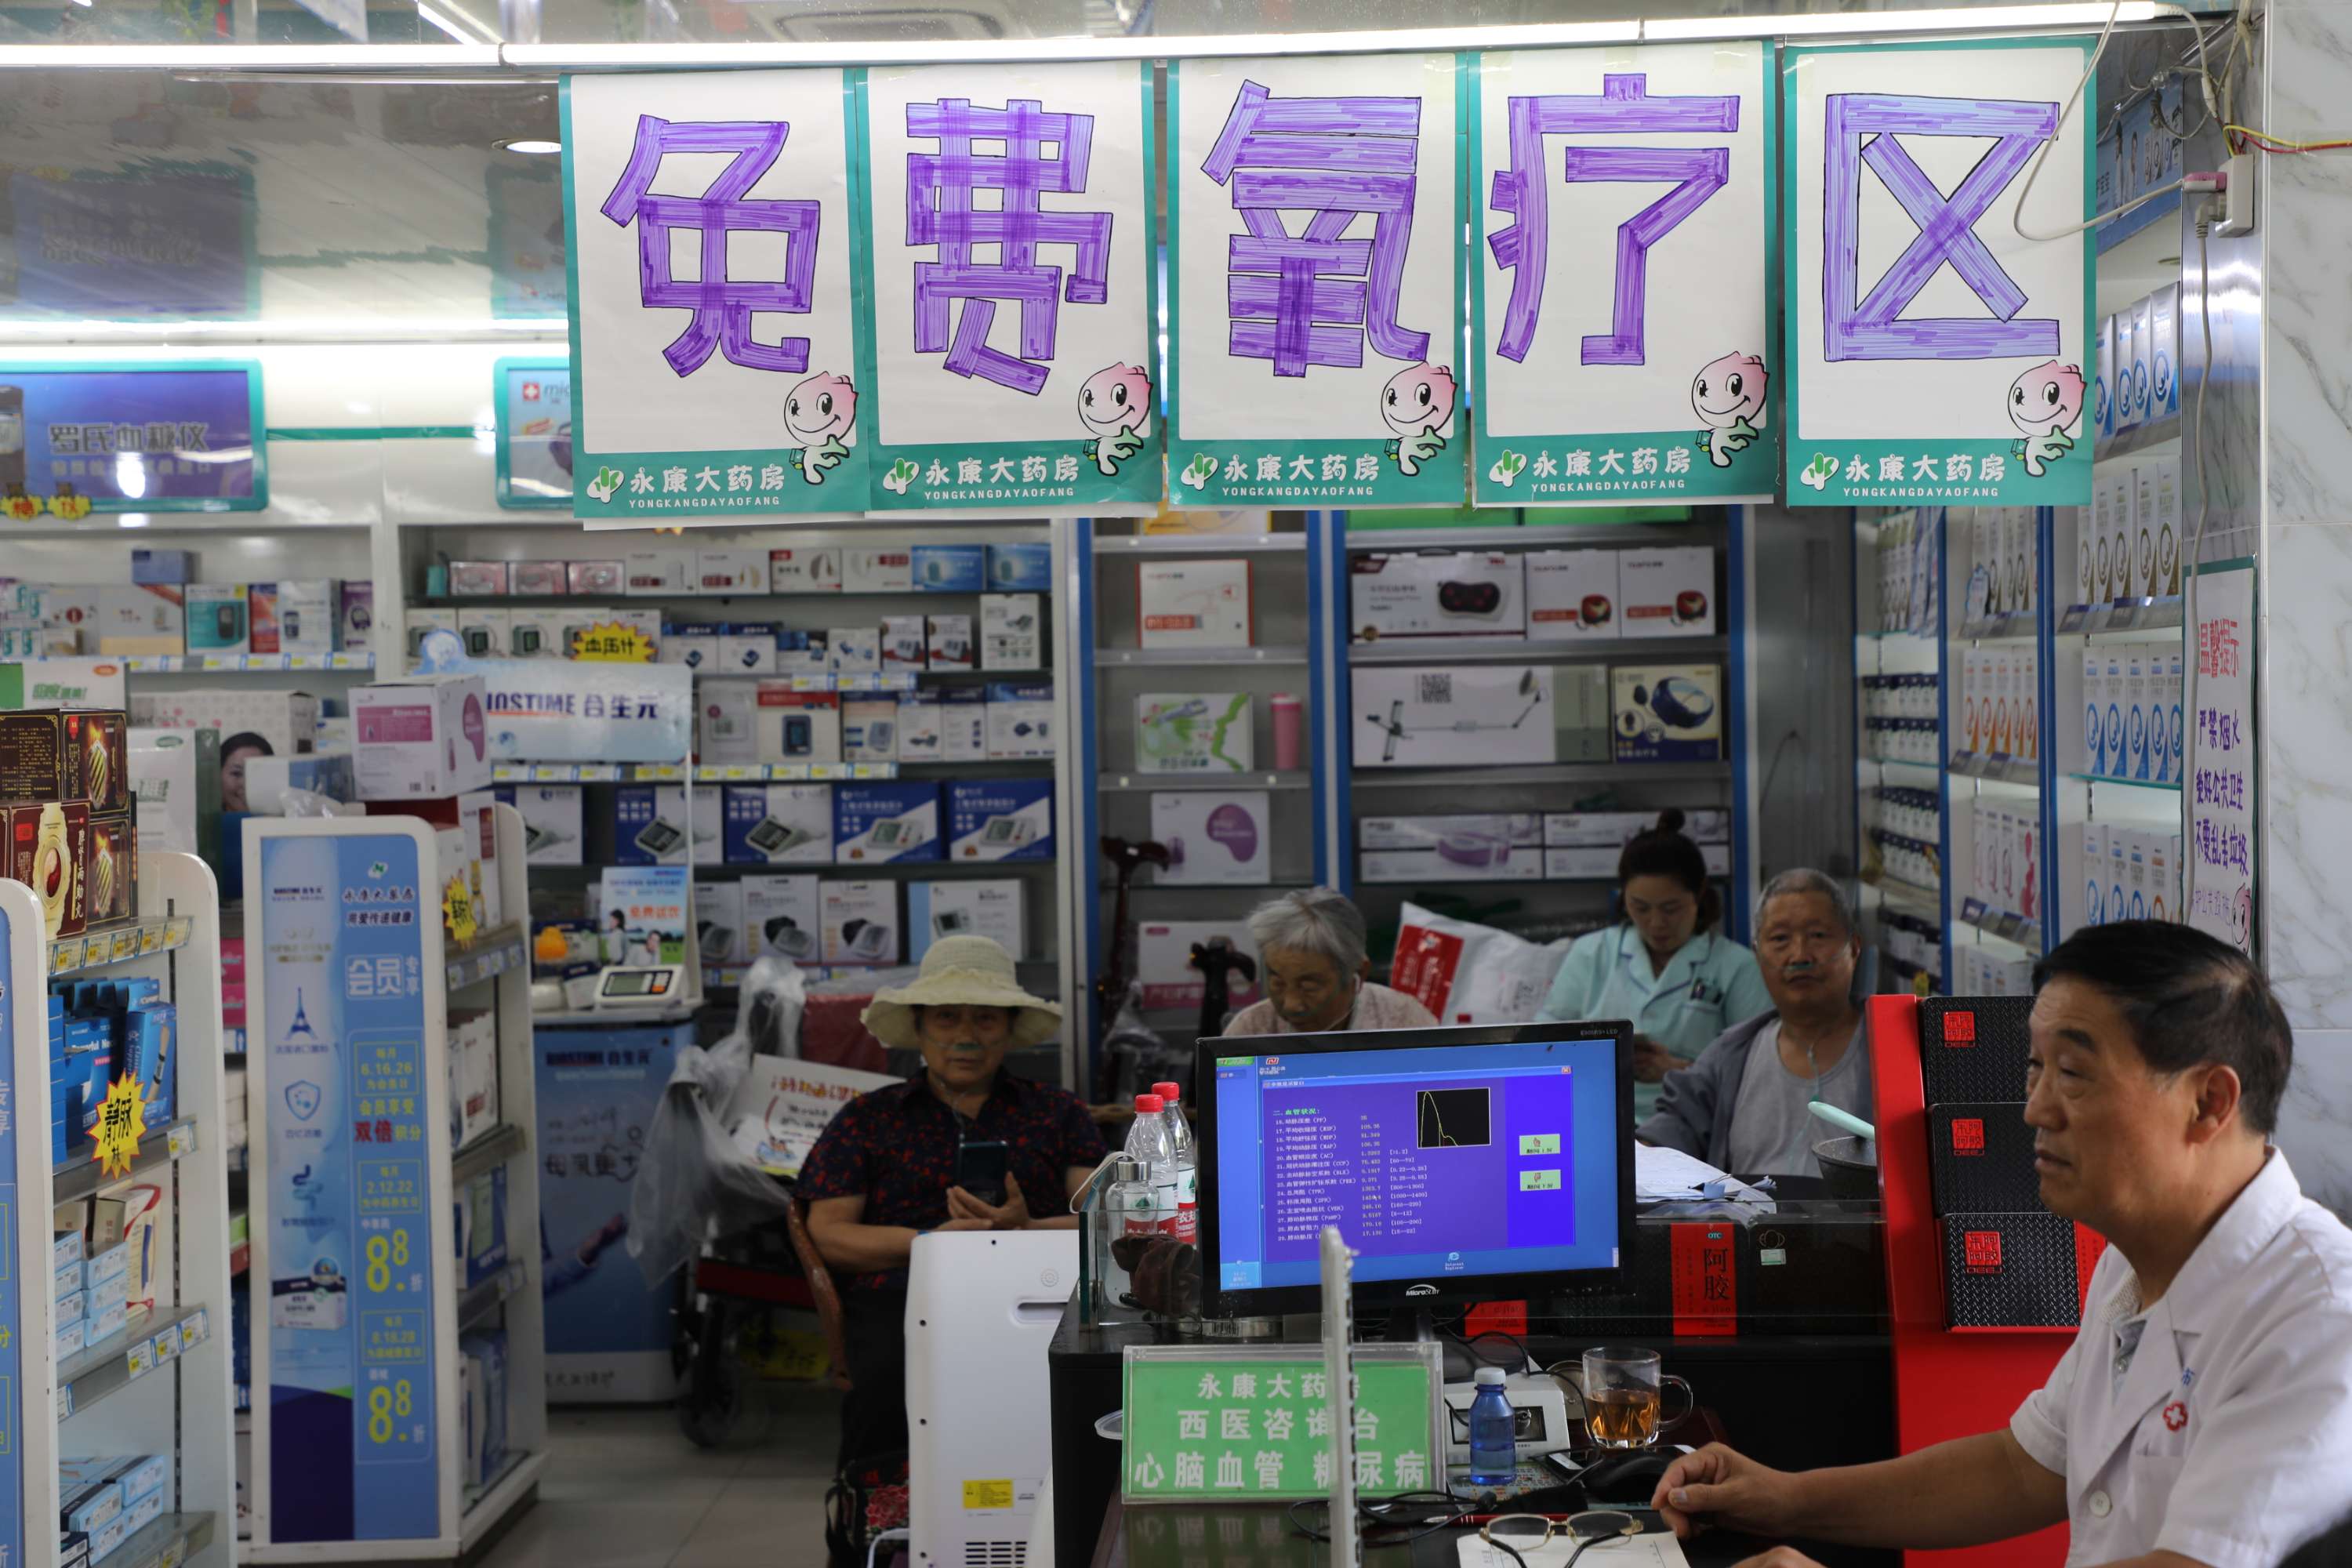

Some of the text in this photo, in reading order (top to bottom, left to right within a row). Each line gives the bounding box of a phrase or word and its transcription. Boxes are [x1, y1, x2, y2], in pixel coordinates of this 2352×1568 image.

[925, 456, 1080, 486] 永康大药房
[1223, 452, 1380, 483] 永康大药房
[1533, 447, 1690, 477] 永康大药房
[1845, 453, 2005, 481] 永康大药房
[630, 464, 785, 493] 永康大药房
[1222, 486, 1374, 496] YONGKANGDAYAOFANG
[1531, 479, 1685, 492] YONGKANGDAYAOFANG
[1844, 487, 1998, 497] YONGKANGDAYAOFANG
[629, 496, 779, 508] YONGKANGDAYAOFANG
[924, 488, 1074, 501] YONGKANGDAYAOFANG
[585, 637, 634, 655] 血压计
[486, 692, 575, 714] IOSTIME
[584, 693, 659, 719] 合生元
[2199, 708, 2241, 750] 严禁烟火
[2196, 818, 2249, 877] 不要乱丢垃圾
[349, 958, 402, 996] 会员
[1704, 1248, 1730, 1301] 阿胶
[1135, 1452, 1283, 1490] 心脑血管
